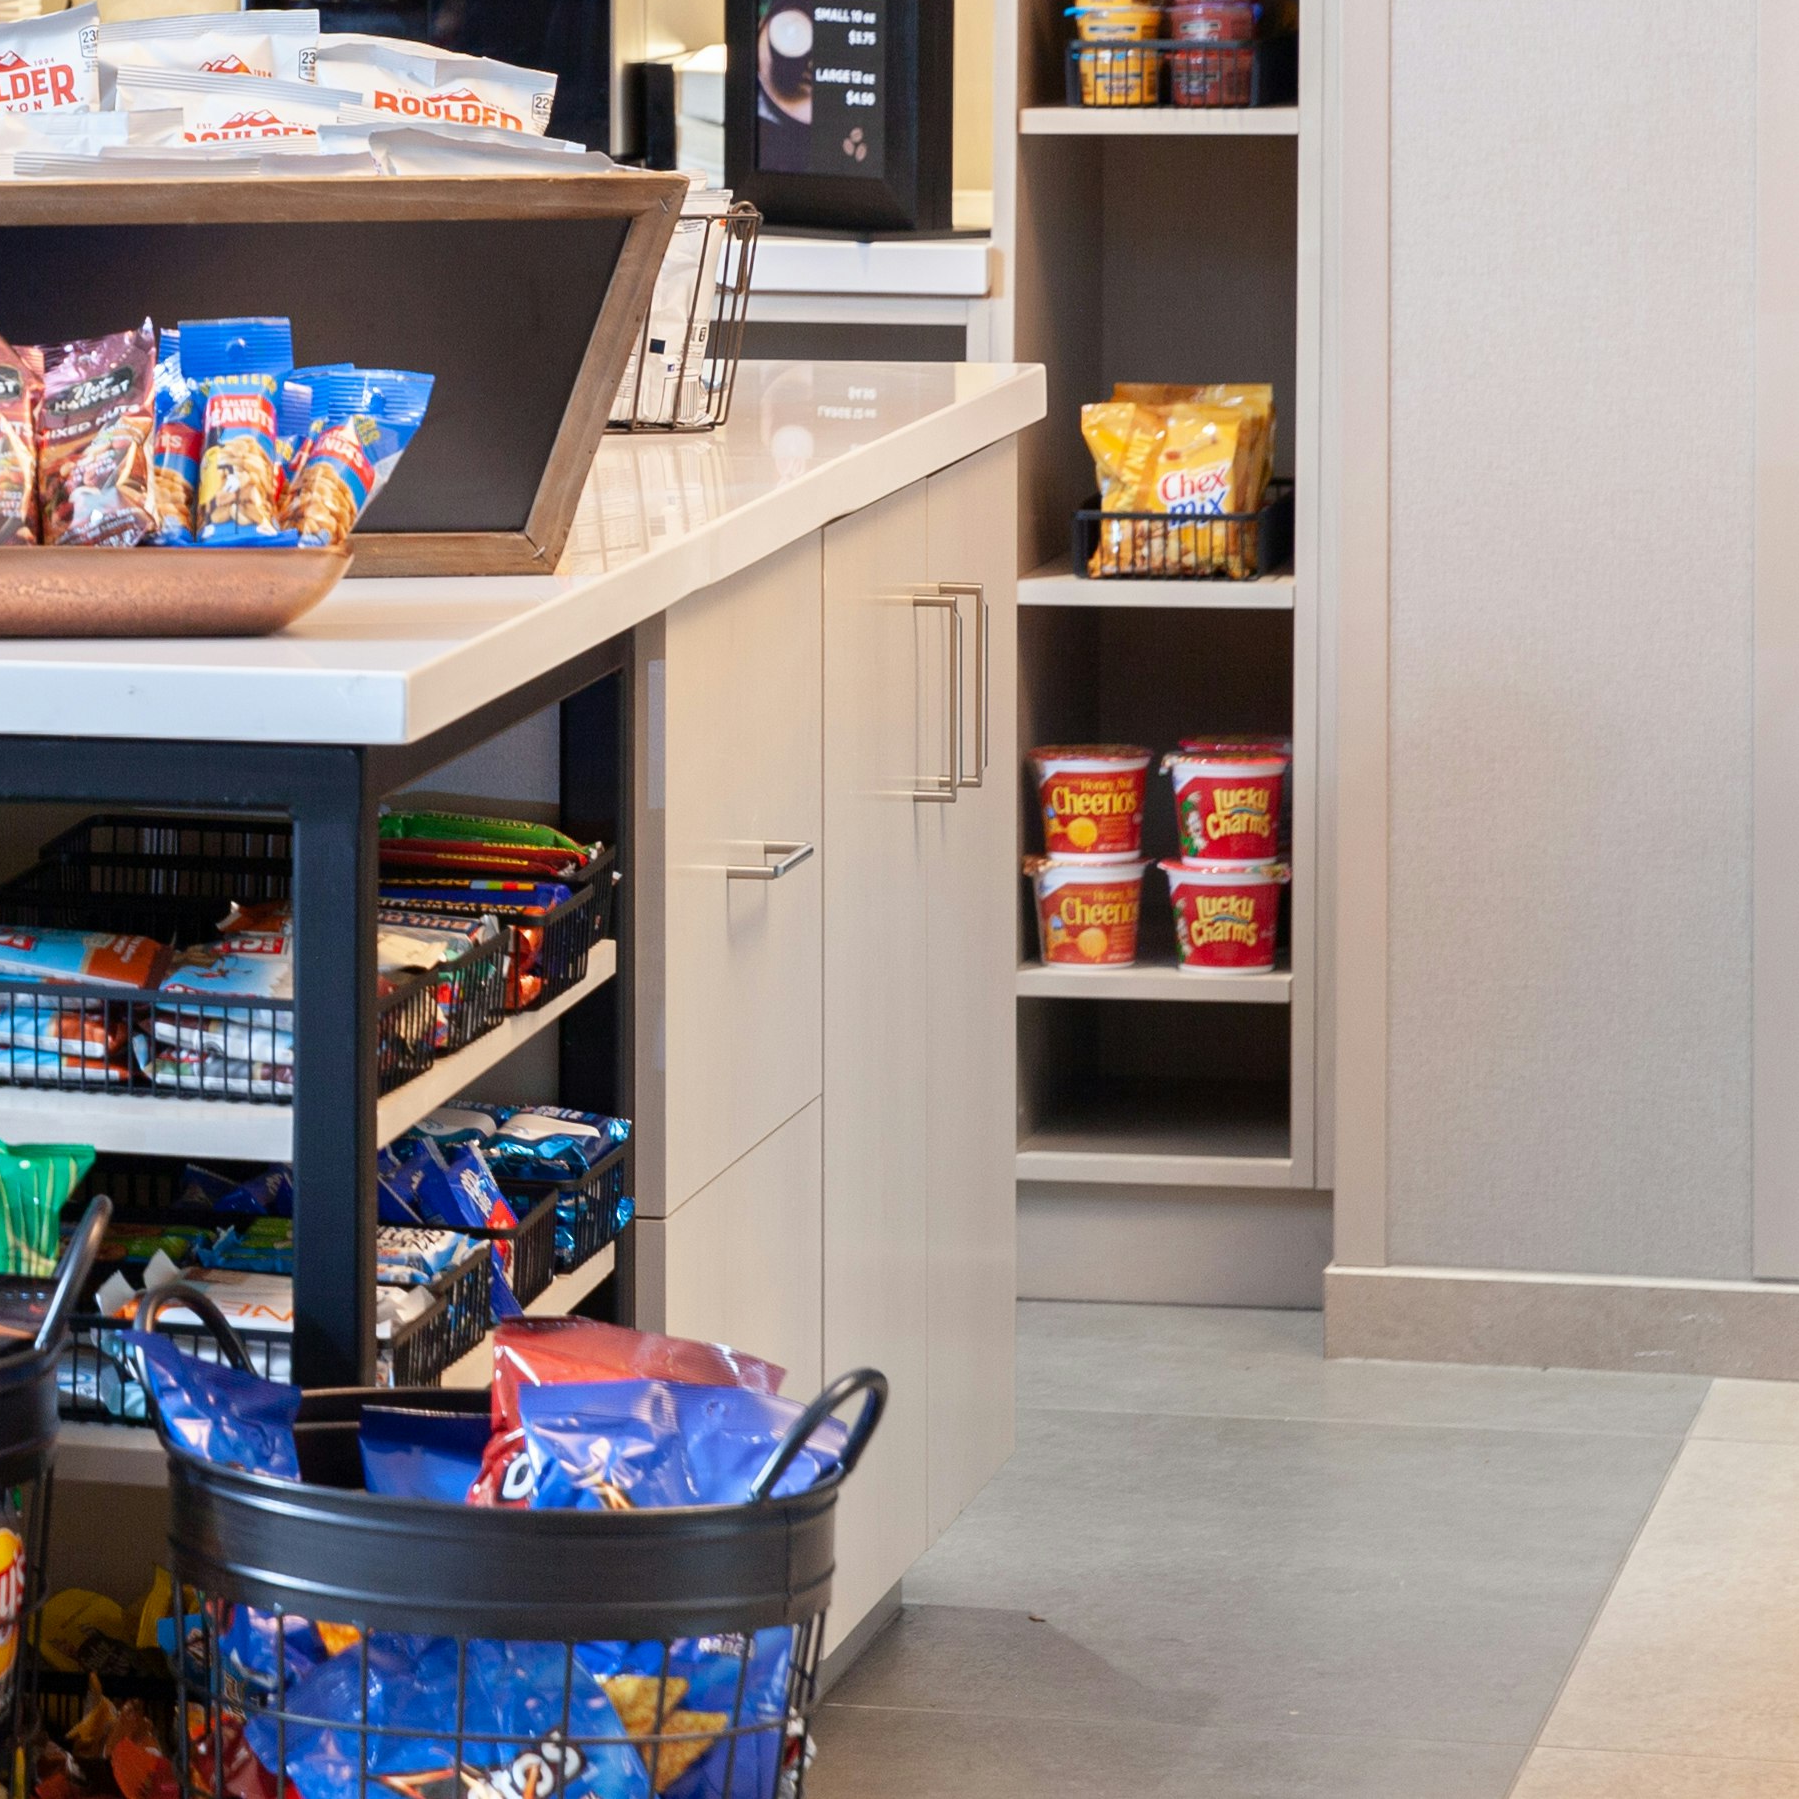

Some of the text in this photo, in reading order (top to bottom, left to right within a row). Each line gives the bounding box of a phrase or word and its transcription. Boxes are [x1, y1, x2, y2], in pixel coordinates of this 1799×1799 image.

[814, 6, 851, 24] SMALL
[815, 67, 850, 84] LARGE
[53, 379, 130, 413] HARVEST
[72, 376, 115, 400] Nut
[92, 403, 141, 427] NUTS
[1161, 466, 1227, 503] Chex
[1051, 785, 1137, 816] Cheerios
[1212, 787, 1271, 810] Lucky
[1205, 812, 1271, 841] Charms
[1195, 895, 1255, 921] Lucky
[1190, 920, 1258, 949] Charms
